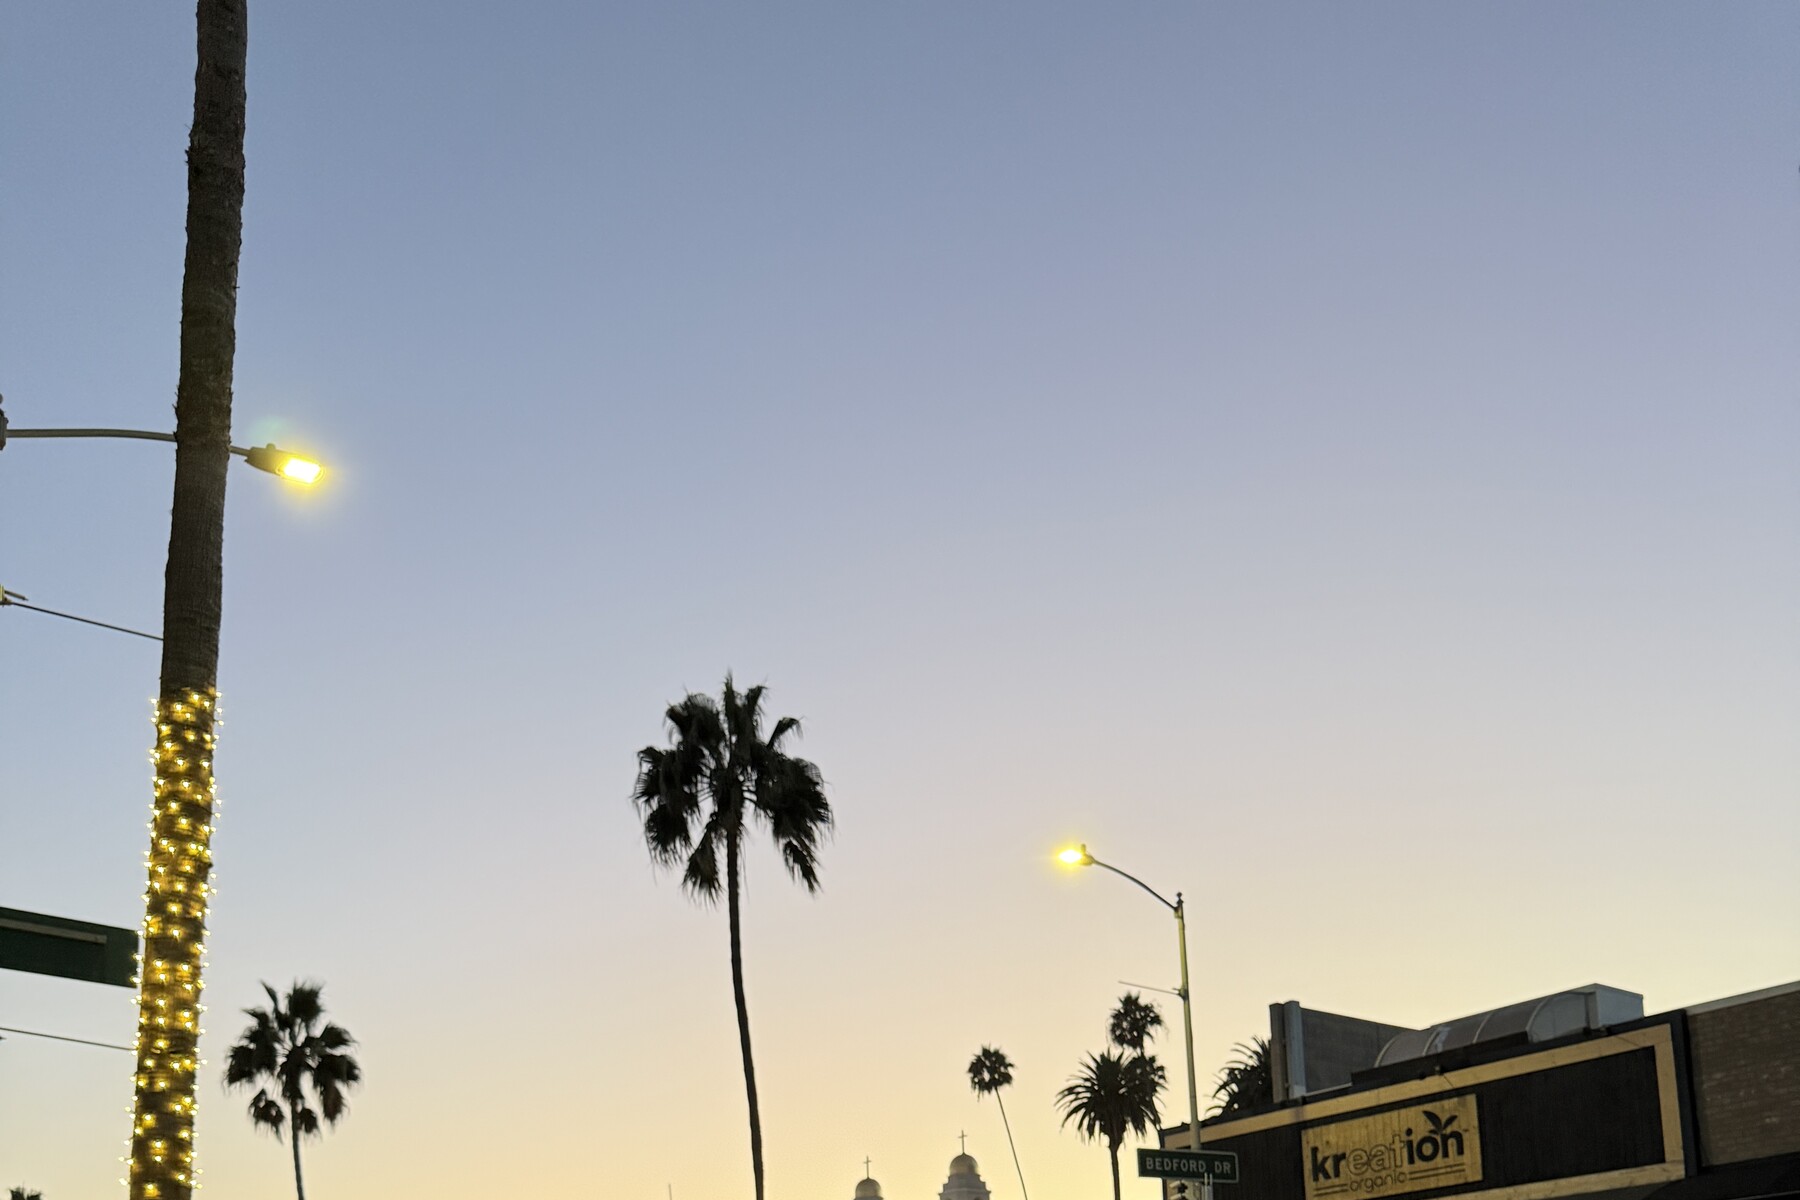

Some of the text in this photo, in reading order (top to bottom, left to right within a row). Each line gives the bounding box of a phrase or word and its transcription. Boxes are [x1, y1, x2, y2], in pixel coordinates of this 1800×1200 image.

[1145, 1157, 1232, 1174] BEDFORD DR
[1310, 1126, 1465, 1183] kreation
[1350, 1171, 1409, 1193] organic
